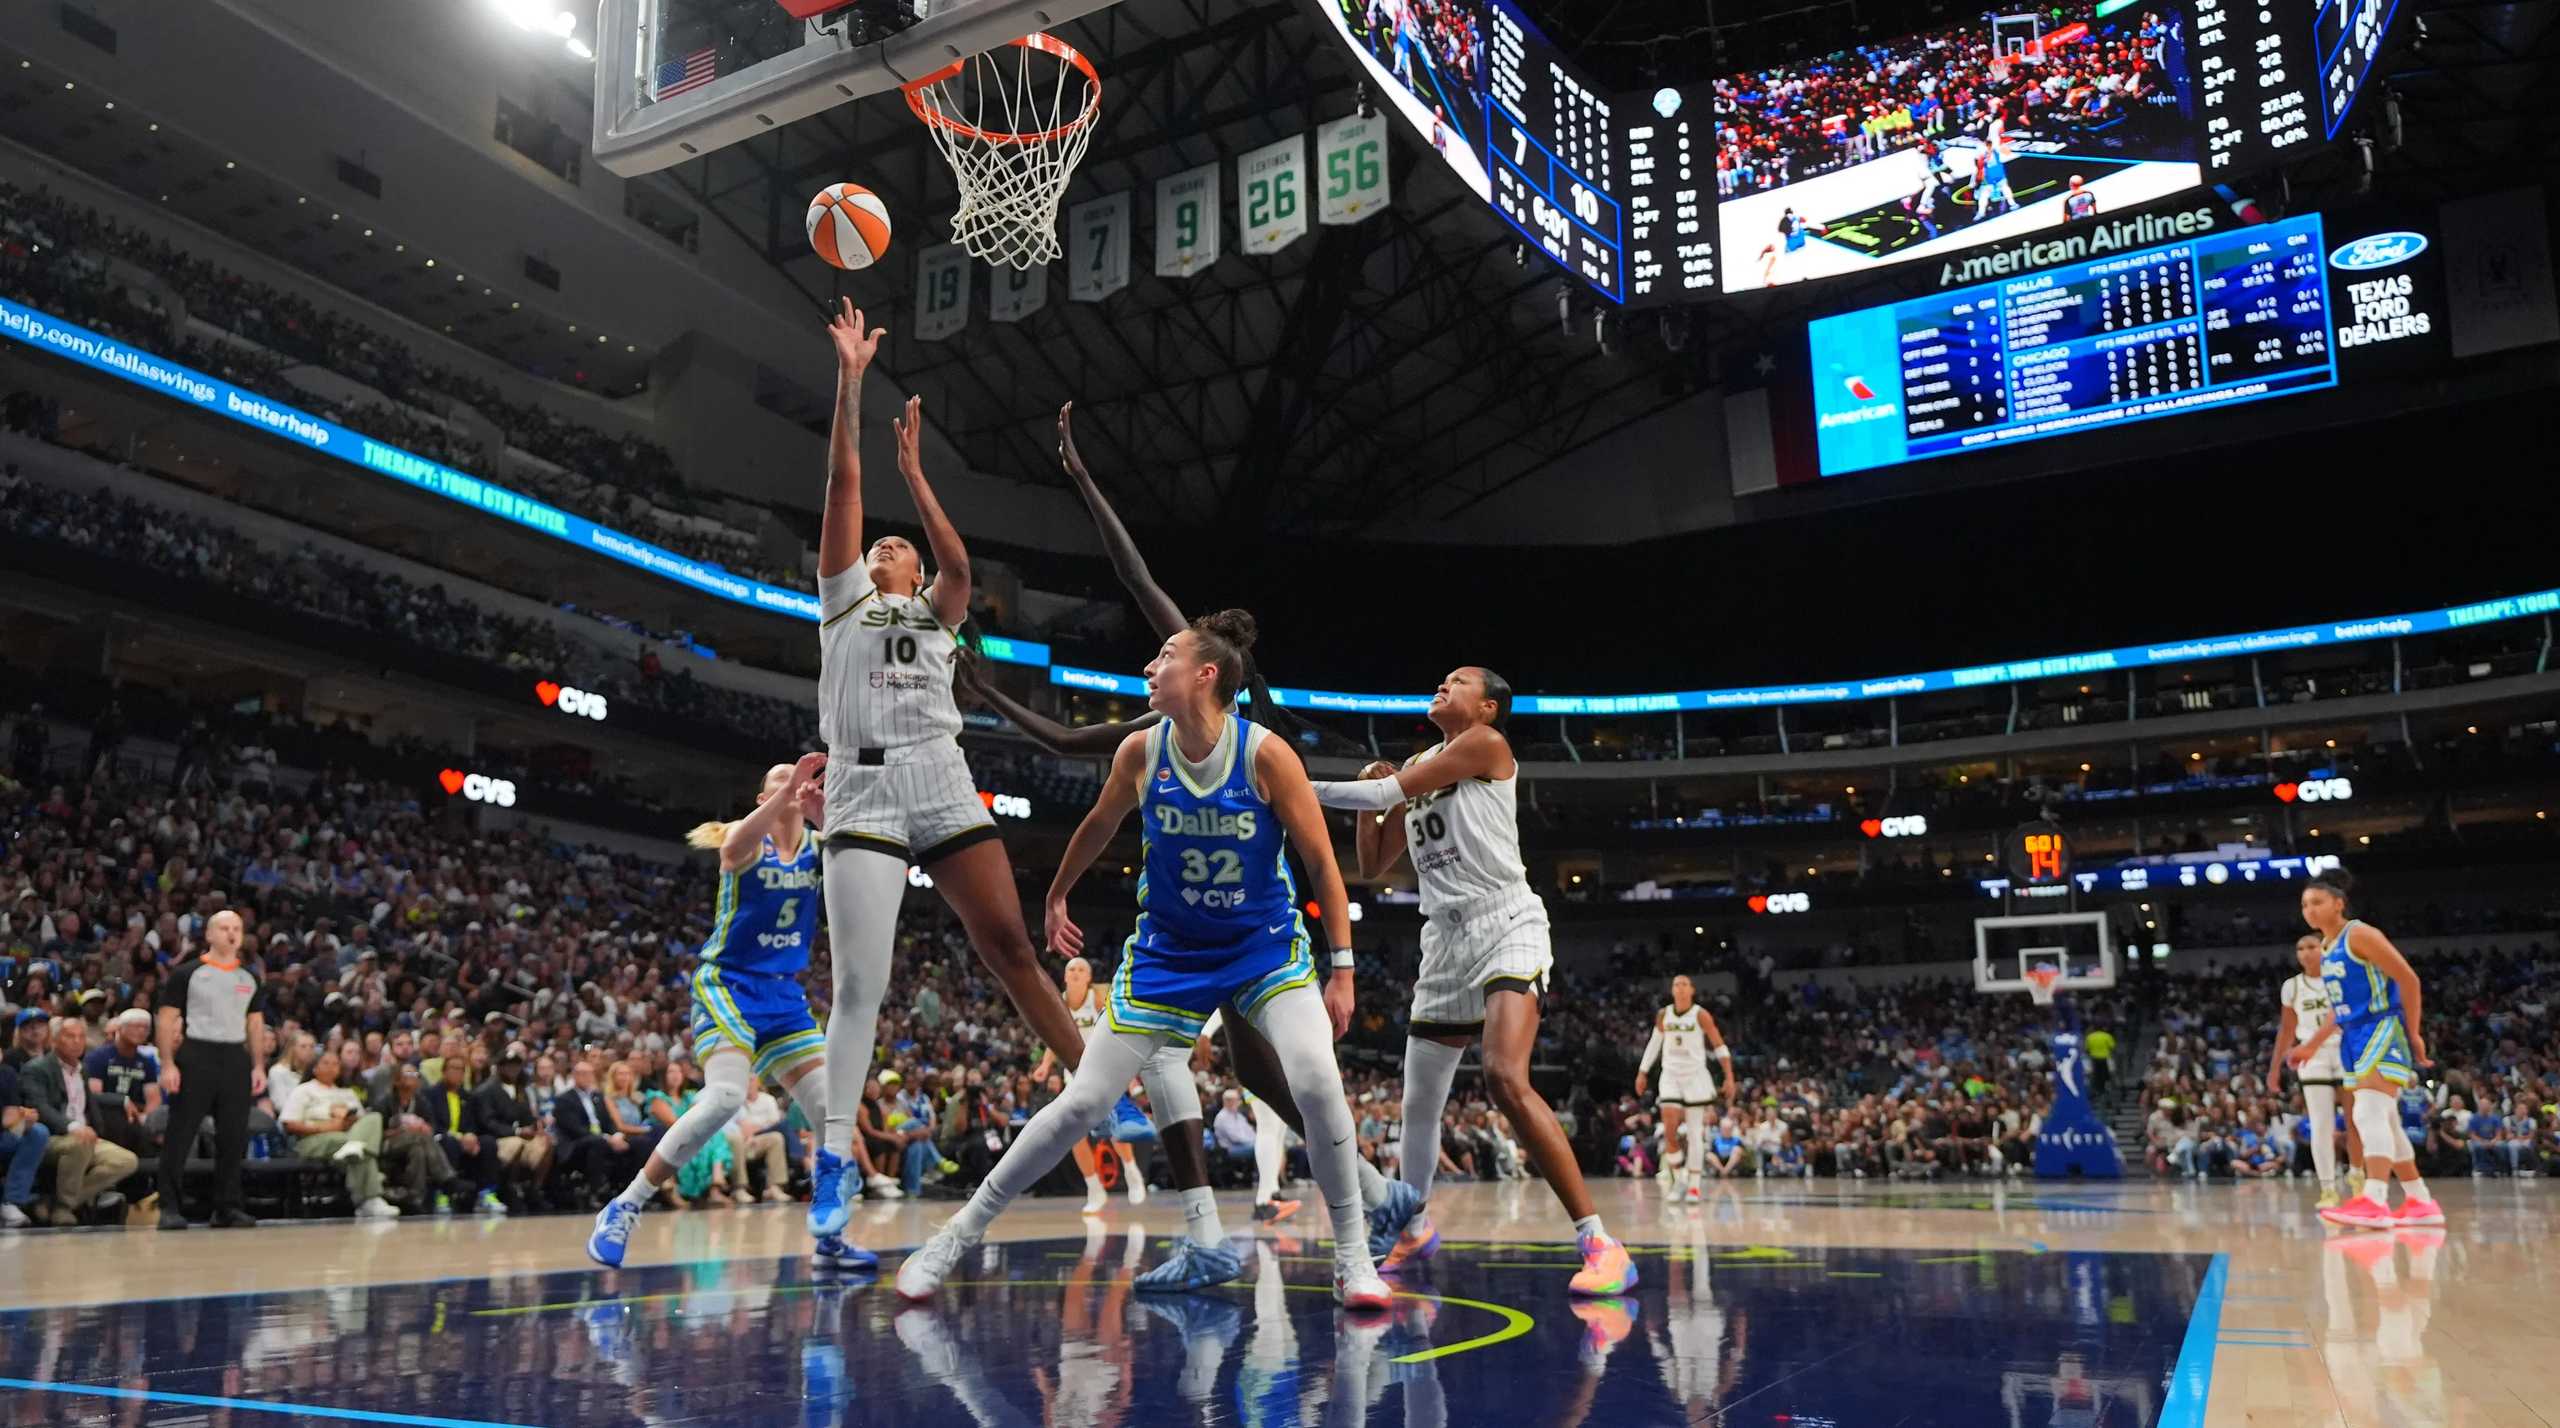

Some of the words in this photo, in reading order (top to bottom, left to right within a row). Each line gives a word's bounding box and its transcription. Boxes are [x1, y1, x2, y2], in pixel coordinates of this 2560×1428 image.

[2199, 28, 2226, 46] STL
[2203, 68, 2236, 89] 3-PT
[2205, 90, 2224, 107] FT
[1511, 127, 1527, 166] 7
[1629, 143, 1648, 155] TO
[2210, 129, 2243, 150] 3-PT
[1328, 140, 1380, 199] 56
[2211, 151, 2231, 168] FT
[1248, 170, 1296, 228] 26
[1570, 183, 1598, 225] 10
[1176, 201, 1198, 248] 9
[1533, 196, 1570, 246] 6:01
[1089, 224, 1109, 272] 7
[1940, 236, 2089, 286] American
[2089, 207, 2215, 254] Airlines
[2349, 237, 2408, 266] Ford
[927, 265, 960, 314] 19
[2006, 276, 2053, 295] DALLAS
[2347, 274, 2413, 304] TEXAS
[2354, 296, 2410, 323] FORD
[2338, 312, 2431, 348] DEALERS
[2013, 346, 2070, 367] CHICAGO
[228, 391, 330, 446] betterhelp
[1820, 404, 1896, 429] American
[362, 440, 440, 488] THERAPY:
[440, 469, 482, 505] YOUR
[483, 486, 514, 514] 6TH
[514, 498, 569, 536] PLAYER.
[592, 528, 749, 599] betterhelp.com/dallaswings
[2446, 600, 2517, 626] THERAPY:
[2517, 592, 2559, 614] YOUR
[2335, 619, 2412, 639] betterhelp
[884, 635, 917, 665] 10
[886, 672, 929, 683] UChicago
[1062, 670, 1119, 692] betterhelp
[2008, 661, 2041, 680] YOUR
[886, 681, 927, 690] Medicine
[1862, 678, 1925, 696] betterhelp
[558, 686, 607, 720] CVS
[463, 773, 516, 807] CVS
[1222, 786, 1250, 799] Albert
[2297, 778, 2352, 802] CVS
[993, 793, 1031, 818] CVS
[1155, 804, 1257, 841] Dallas
[1412, 812, 1445, 847] 30
[1881, 815, 1926, 837] CVS
[1180, 848, 1244, 884] 32
[2031, 849, 2061, 878] 14
[776, 898, 799, 928] 5
[1203, 888, 1245, 909] CVS
[1766, 892, 1810, 913] CVS
[2303, 999, 2326, 1012] SK
